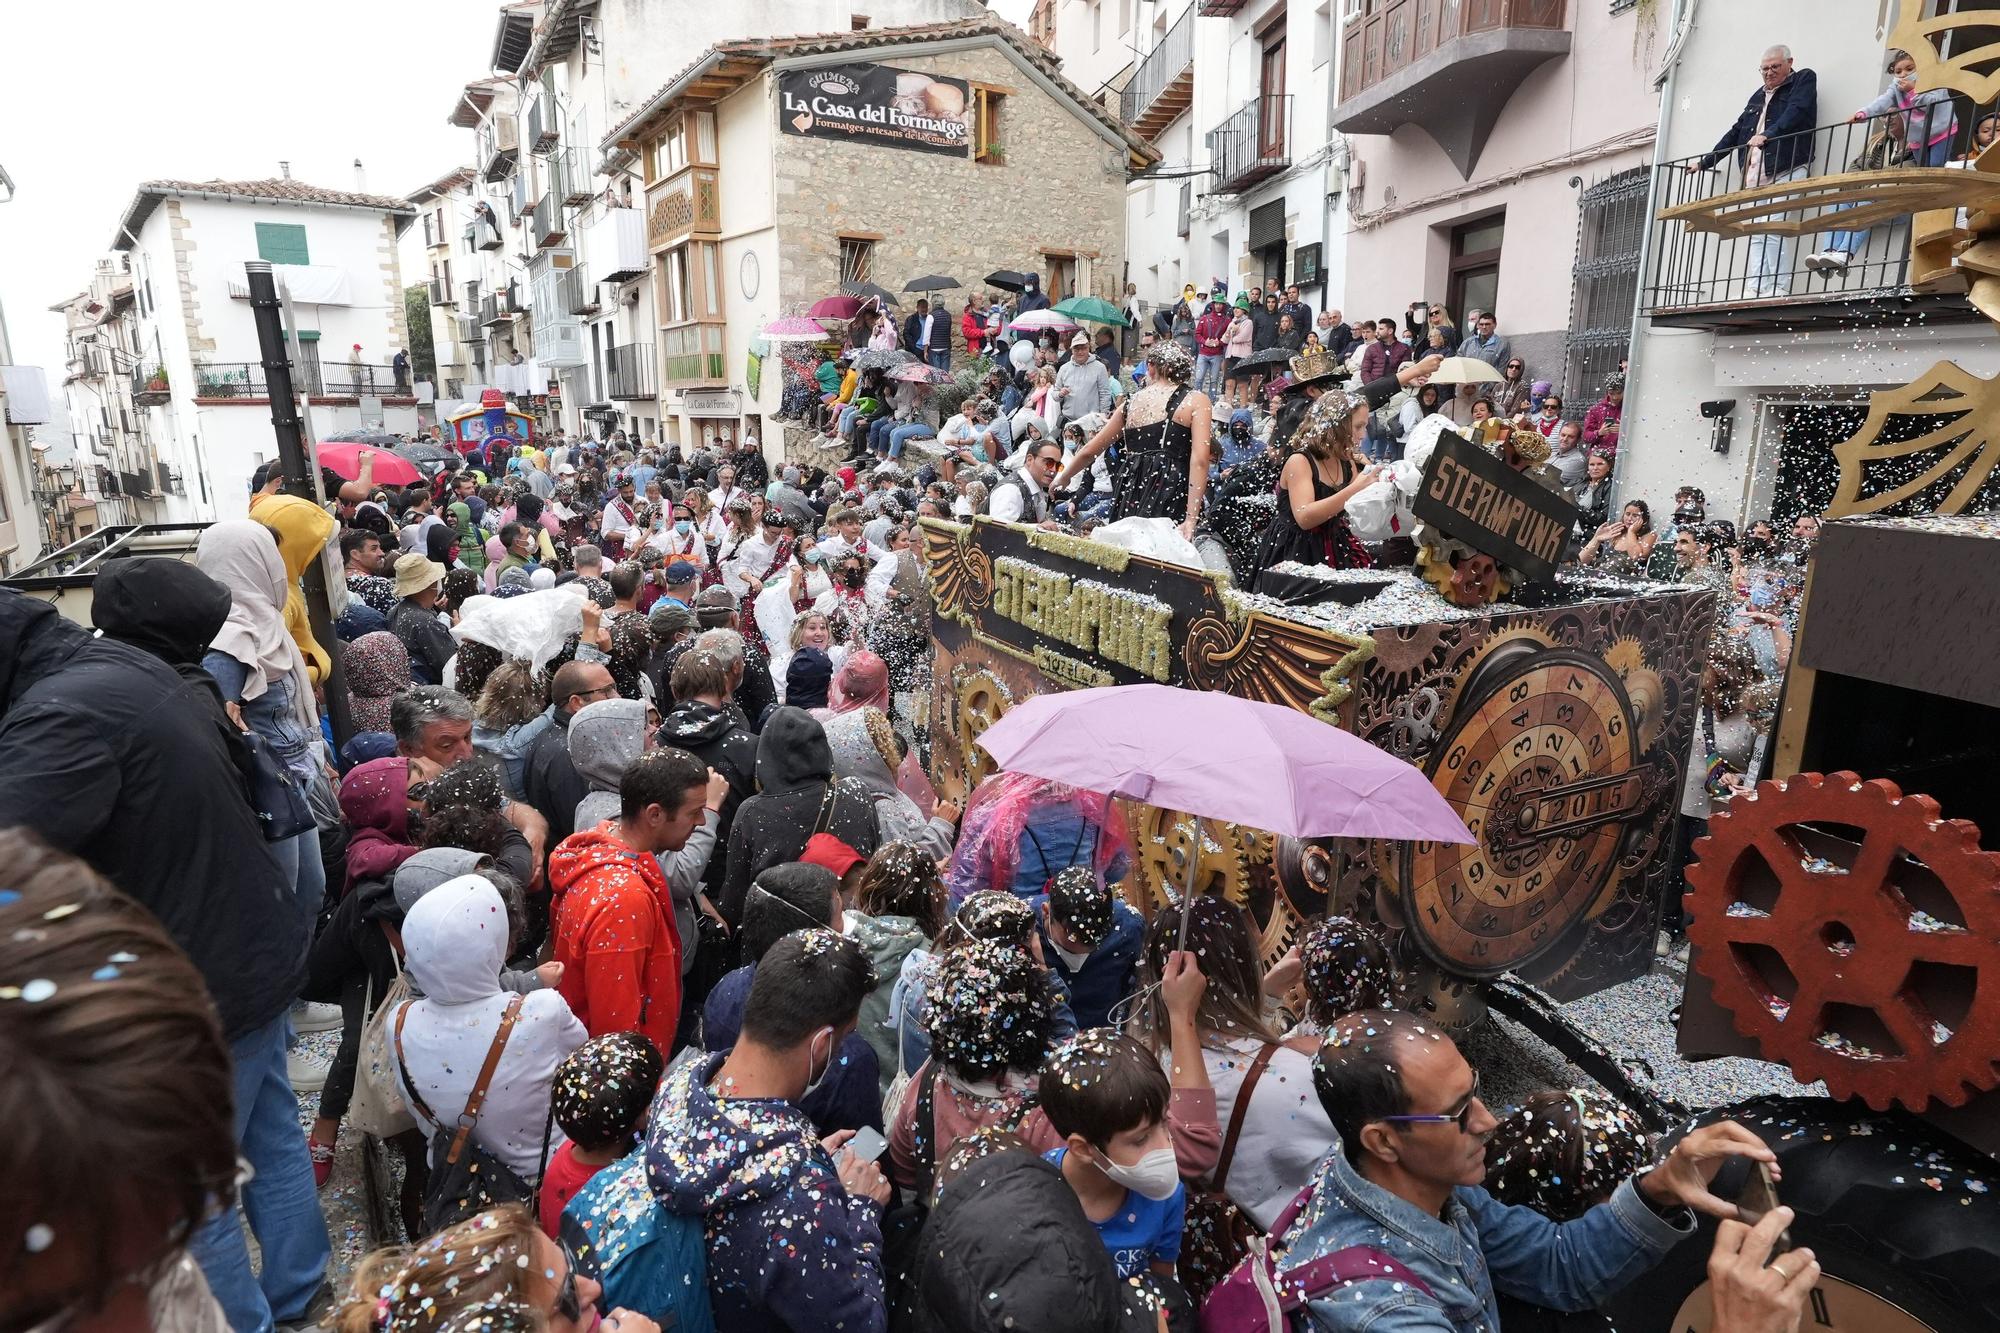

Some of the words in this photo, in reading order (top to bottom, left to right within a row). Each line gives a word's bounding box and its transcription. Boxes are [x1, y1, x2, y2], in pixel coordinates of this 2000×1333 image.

[784, 92, 809, 113] La
[811, 96, 856, 120] Casa
[859, 103, 886, 124] del
[889, 107, 965, 140] Formatge
[816, 117, 864, 134] Formatges
[866, 126, 903, 138] artesans
[927, 134, 963, 146] comarca
[695, 400, 705, 408] Casa
[1430, 455, 1566, 564] STEAMPUNK
[1510, 681, 1529, 703] 8
[1511, 709, 1529, 727] 4
[1514, 736, 1531, 757] 3
[1546, 733, 1563, 752] 2
[1479, 772, 1495, 796] 4
